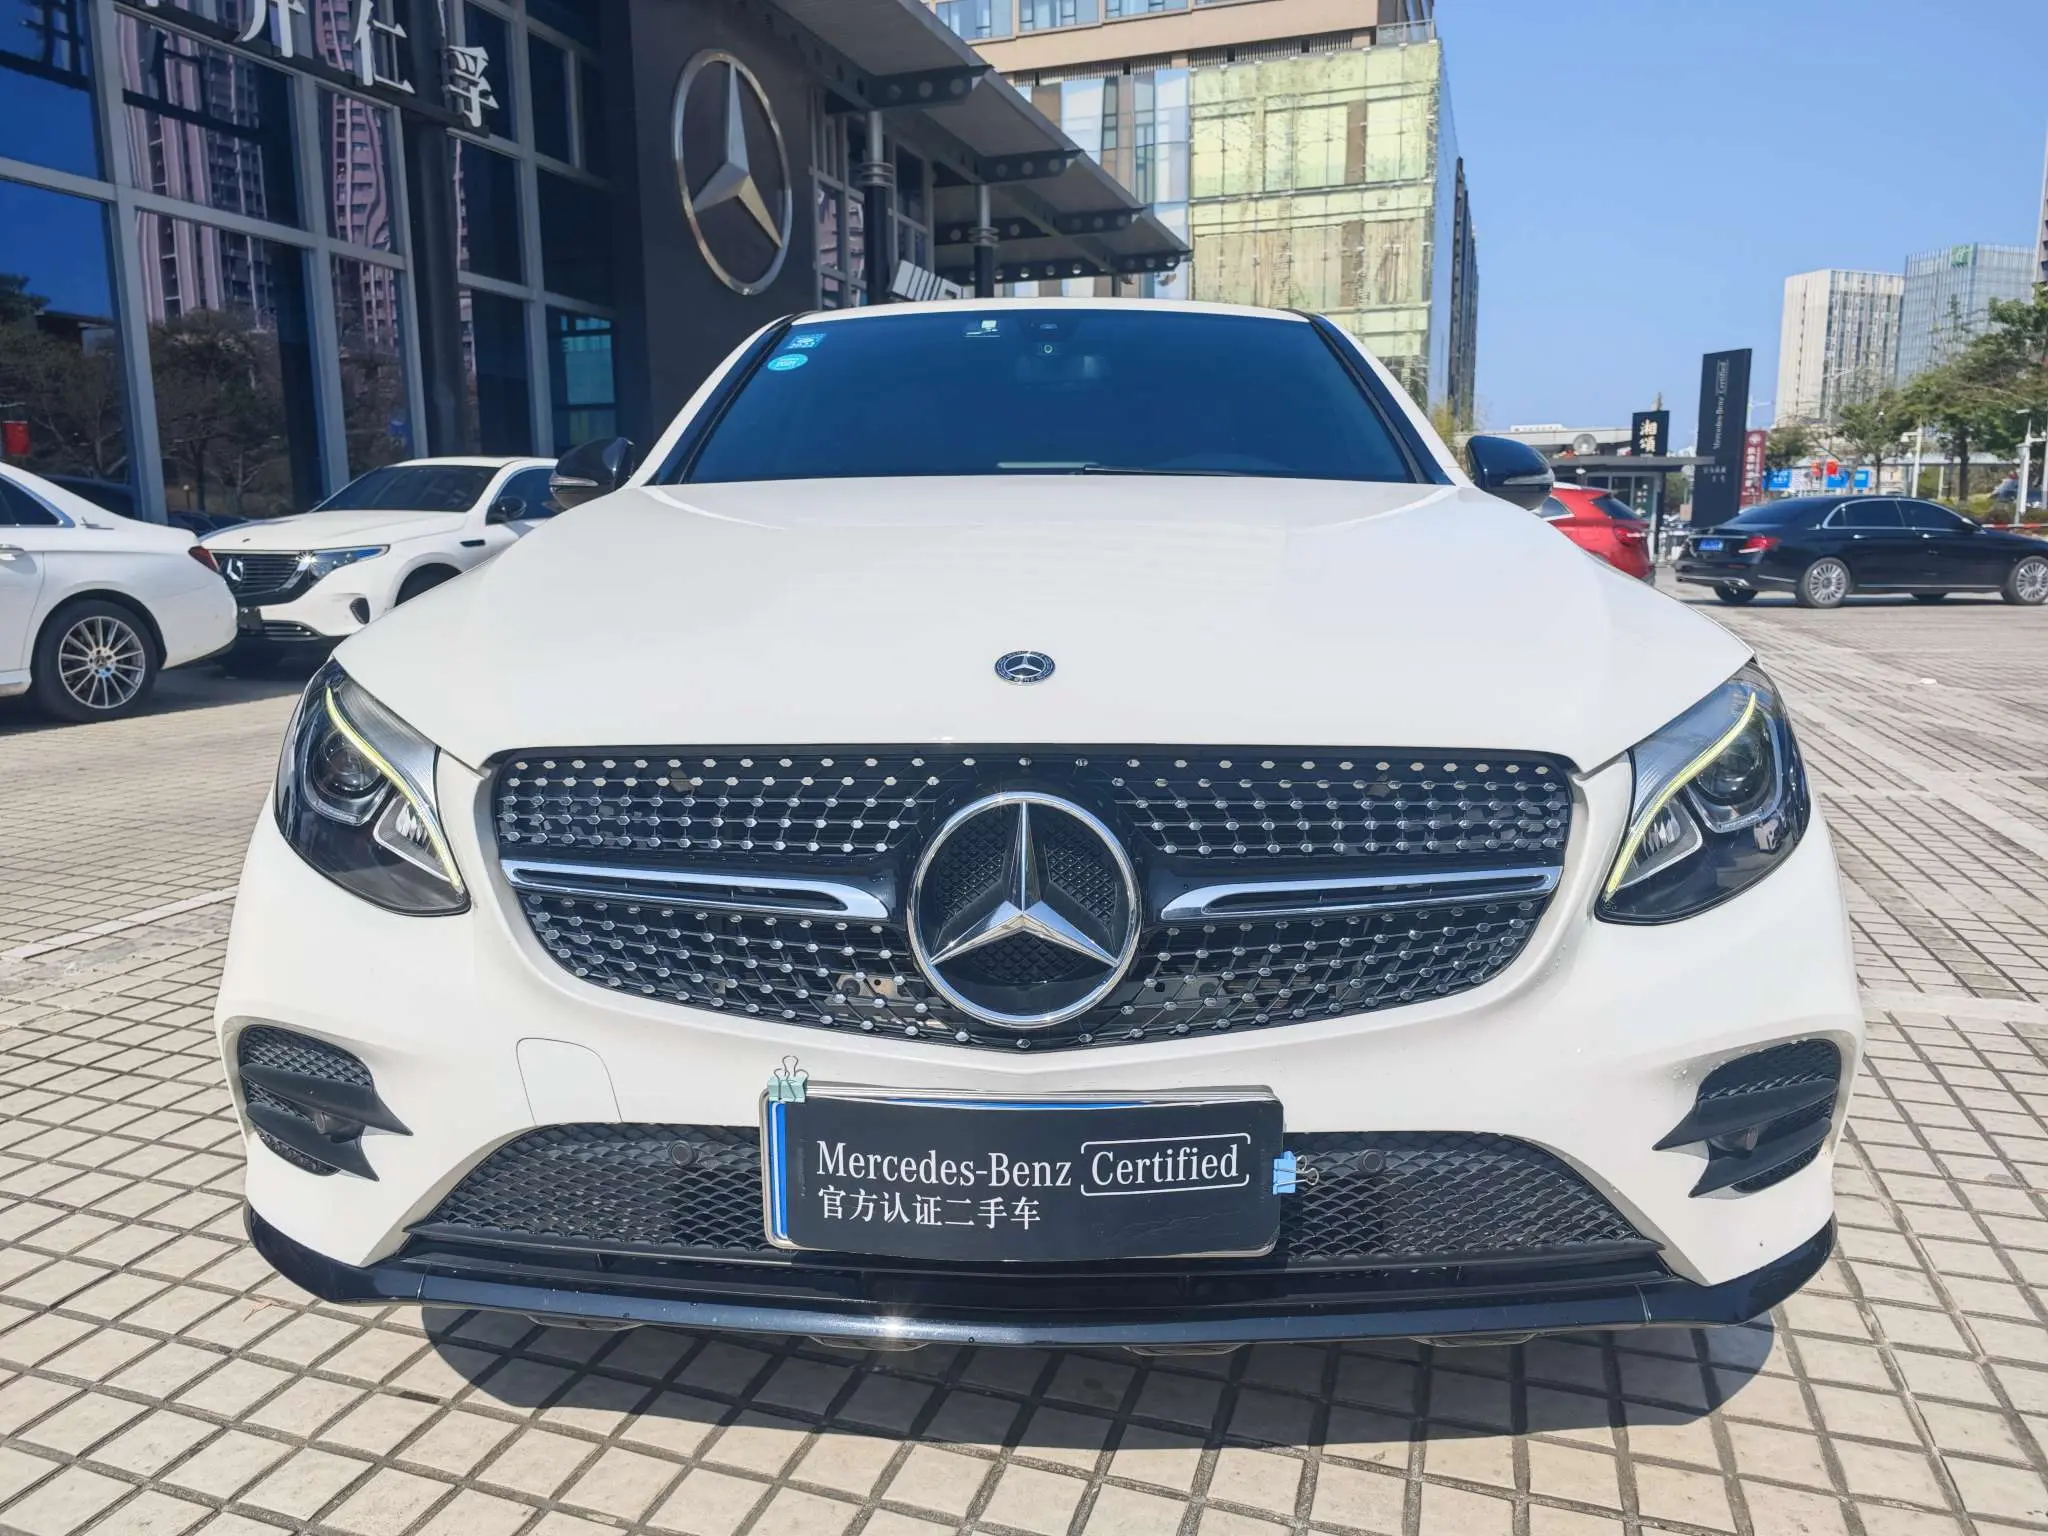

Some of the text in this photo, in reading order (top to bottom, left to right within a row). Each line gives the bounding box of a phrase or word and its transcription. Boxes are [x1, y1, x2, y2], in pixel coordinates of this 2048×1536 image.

[816, 1140, 1072, 1187] Mercedes-Benz
[1091, 1144, 1239, 1186] Certified
[818, 1185, 1041, 1230] 官方认证二手车
